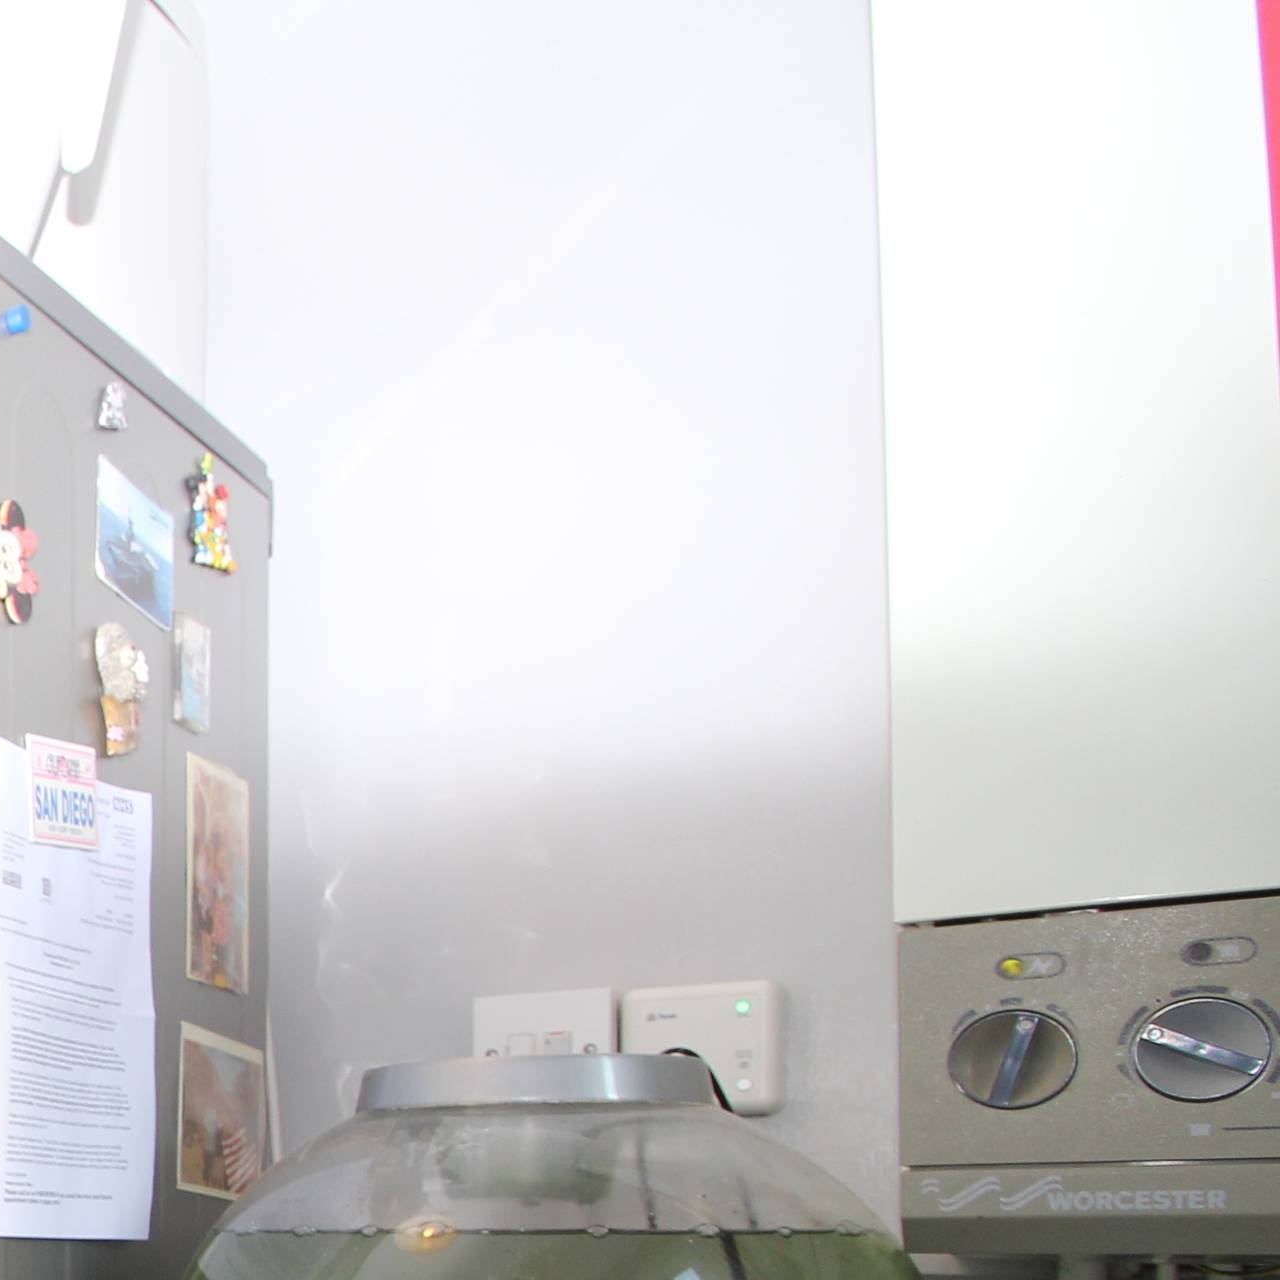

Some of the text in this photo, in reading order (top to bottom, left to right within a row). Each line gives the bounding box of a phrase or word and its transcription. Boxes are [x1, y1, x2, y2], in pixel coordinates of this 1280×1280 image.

[34, 784, 59, 822] SAN
[61, 788, 95, 829] DIEGO
[1047, 1190, 1227, 1212] WORCESTER
